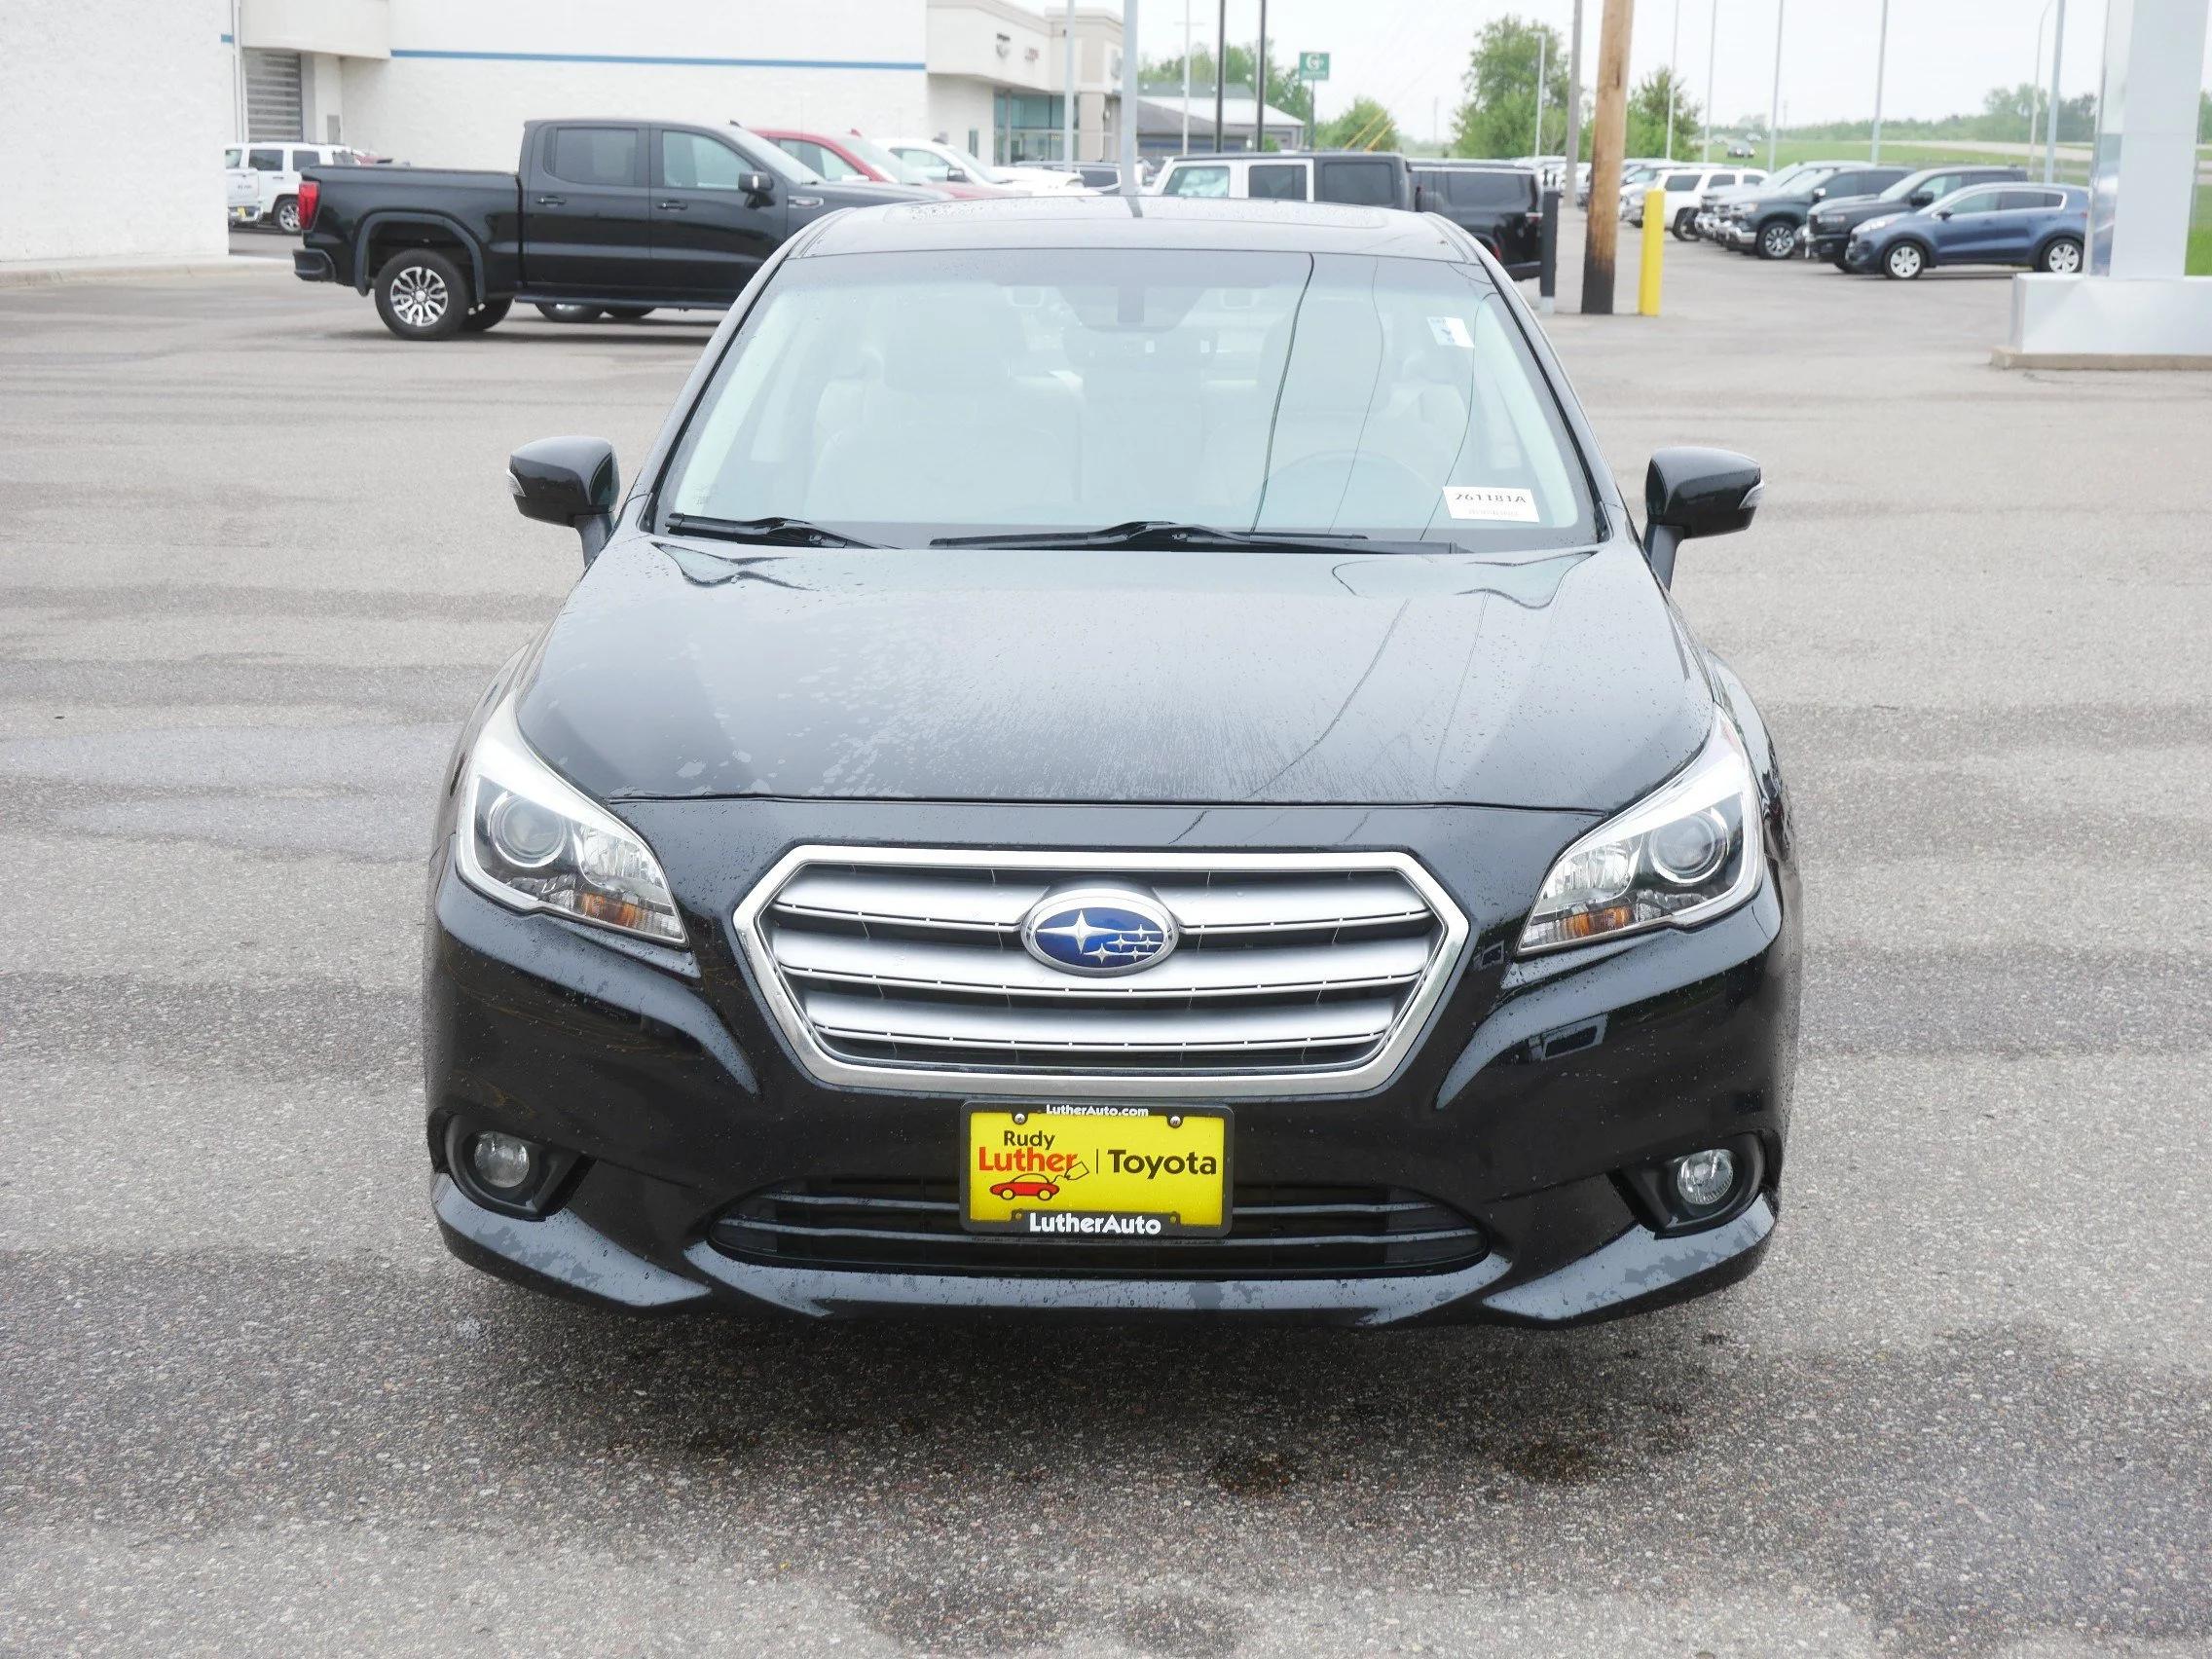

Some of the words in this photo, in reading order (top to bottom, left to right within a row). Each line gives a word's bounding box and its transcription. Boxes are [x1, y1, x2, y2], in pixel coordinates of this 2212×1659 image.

[1046, 1104, 1149, 1118] LutherAuto.com
[1004, 1130, 1055, 1151] Rudy
[979, 1147, 1078, 1172] Luther
[1107, 1149, 1217, 1179] Toyota
[1029, 1213, 1161, 1235] LutherAuto
